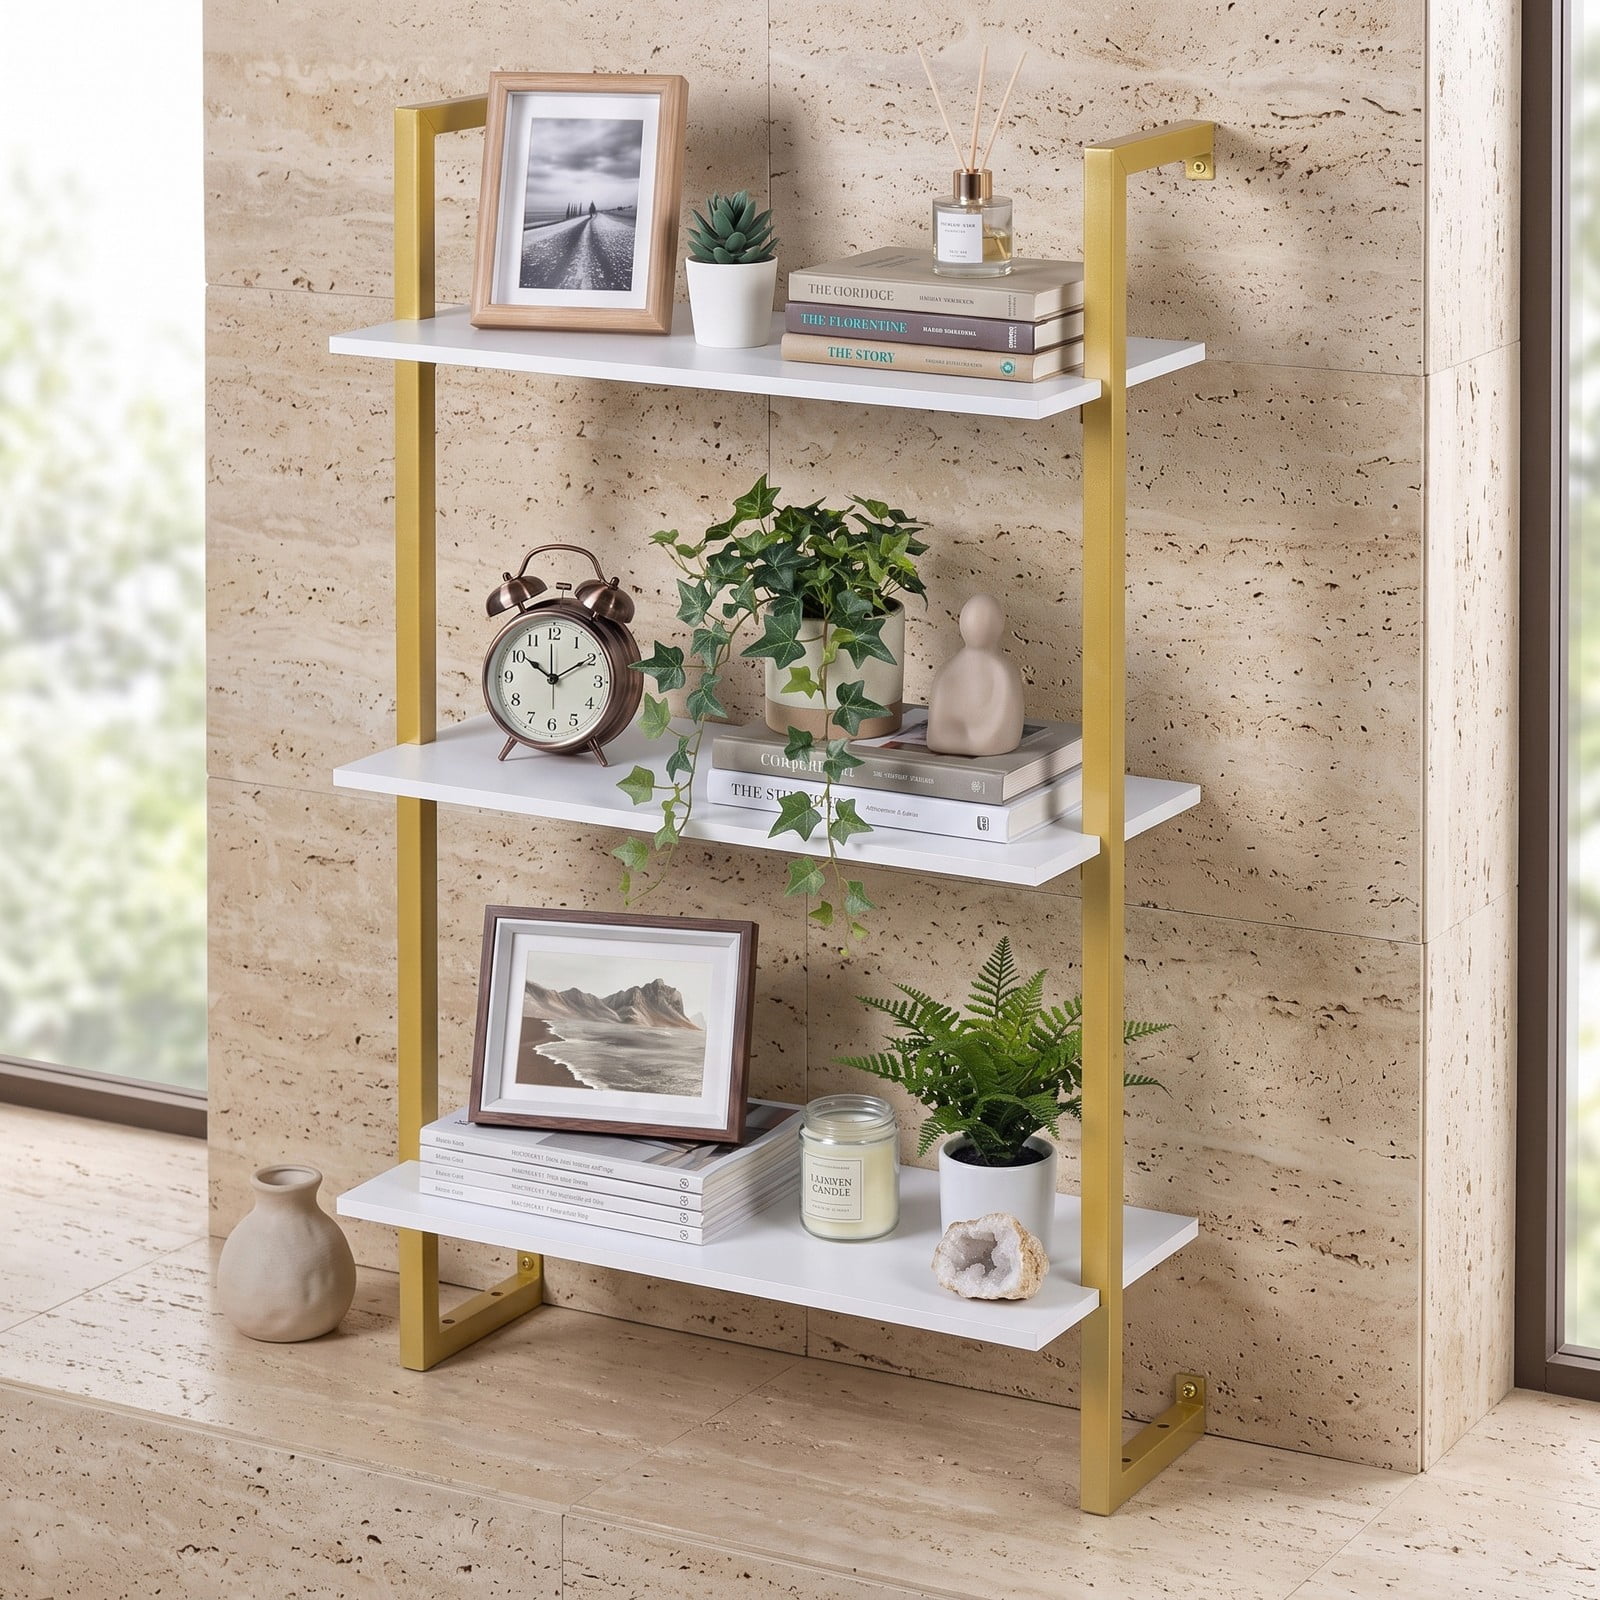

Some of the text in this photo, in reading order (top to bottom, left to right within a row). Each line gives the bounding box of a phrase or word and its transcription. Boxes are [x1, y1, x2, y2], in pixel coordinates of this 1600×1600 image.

[808, 283, 832, 296] THE
[800, 313, 909, 334] THE FLORENTINE
[828, 346, 896, 364] THE STORY
[527, 634, 539, 647] 11
[547, 627, 561, 641] 12
[574, 636, 579, 649] 1
[512, 650, 526, 663] 10
[587, 652, 597, 666] 2
[504, 670, 514, 684] 9
[593, 675, 603, 688] 3
[511, 692, 521, 706] 8
[585, 697, 595, 710] 4
[526, 711, 536, 724] 7
[568, 713, 579, 726] 5
[547, 718, 557, 731] 6
[731, 783, 762, 800] THE
[812, 1184, 851, 1197] CANDLE
